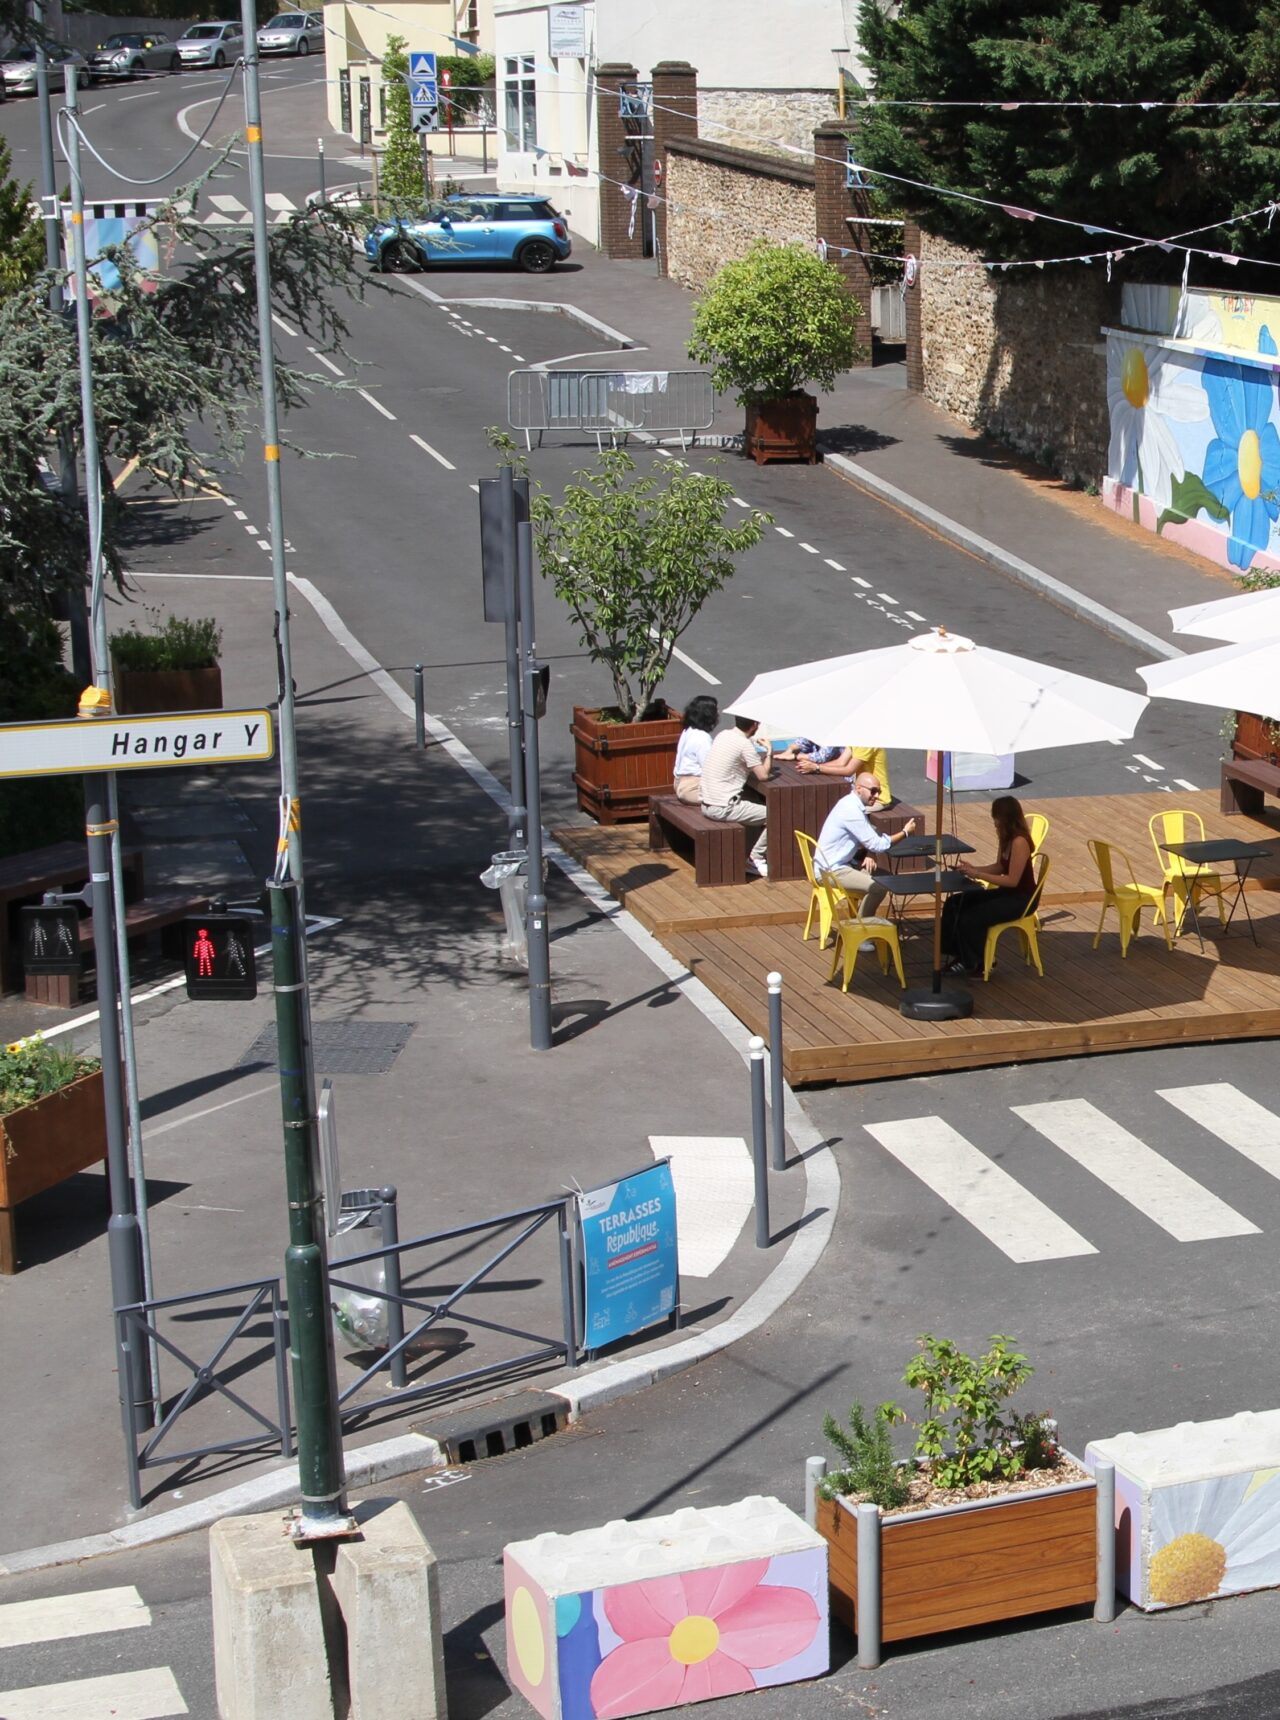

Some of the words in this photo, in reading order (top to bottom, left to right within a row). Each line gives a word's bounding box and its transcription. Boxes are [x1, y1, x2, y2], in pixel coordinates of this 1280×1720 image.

[111, 732, 222, 758] Hangar
[244, 723, 260, 747] Y
[599, 1197, 662, 1234] TERRASSES
